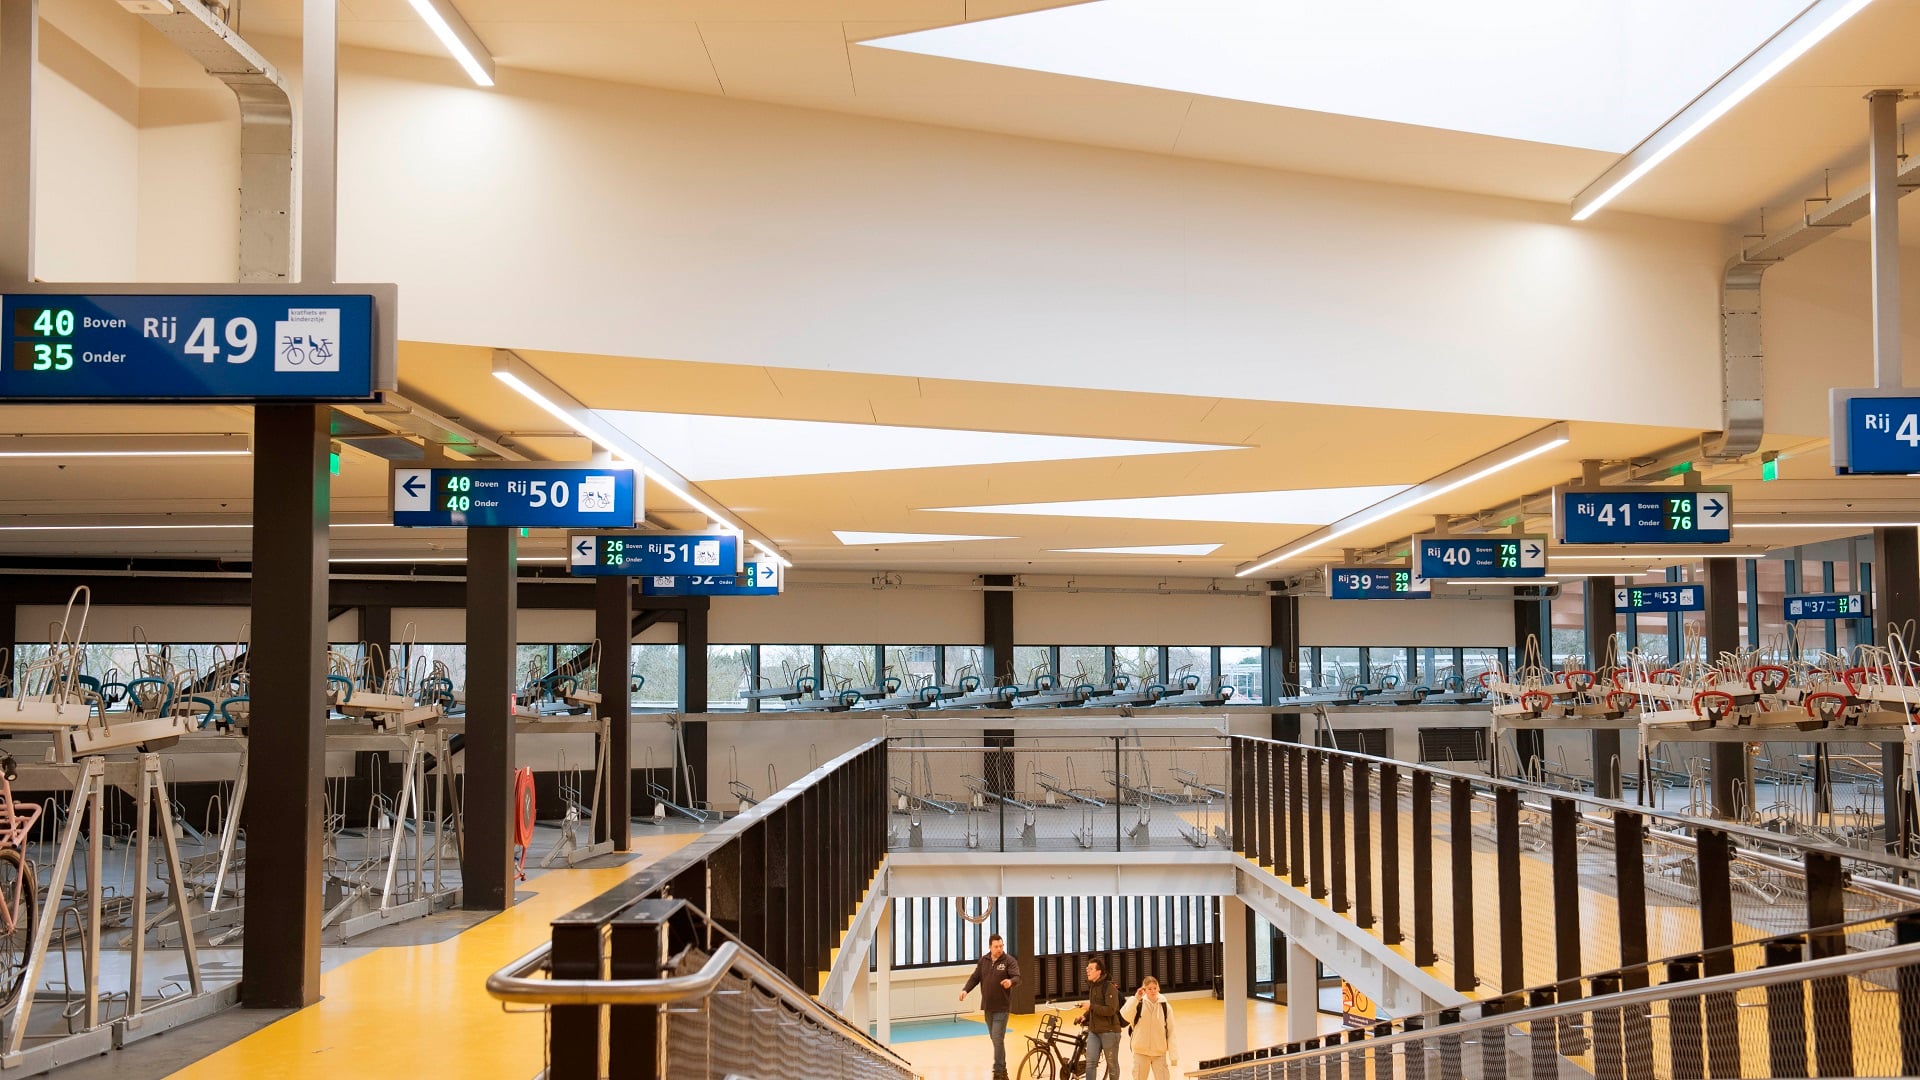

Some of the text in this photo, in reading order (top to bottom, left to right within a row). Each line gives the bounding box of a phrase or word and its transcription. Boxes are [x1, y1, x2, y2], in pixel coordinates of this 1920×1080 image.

[33, 310, 126, 336] 40 Boven
[144, 317, 258, 363] Rij 49
[33, 344, 126, 370] 35 Onder
[1866, 414, 1890, 433] Rij
[447, 476, 499, 492] 40 Boven
[508, 481, 569, 508] Rij 50
[446, 496, 499, 511] 40 Onder
[1671, 500, 1691, 513] 76
[1578, 504, 1631, 527] Rij 41
[1671, 517, 1692, 530] 76
[607, 541, 623, 552] 26
[648, 544, 688, 563] Rij 51
[1501, 545, 1517, 555] 76
[607, 554, 623, 565] 26
[1428, 548, 1471, 566] Rij 40
[1501, 557, 1517, 568] 76
[1339, 575, 1372, 590] Rij 39
[1396, 573, 1408, 581] 20
[1396, 583, 1409, 592] 22
[1663, 592, 1677, 604] 53
[1812, 601, 1825, 613] 37
